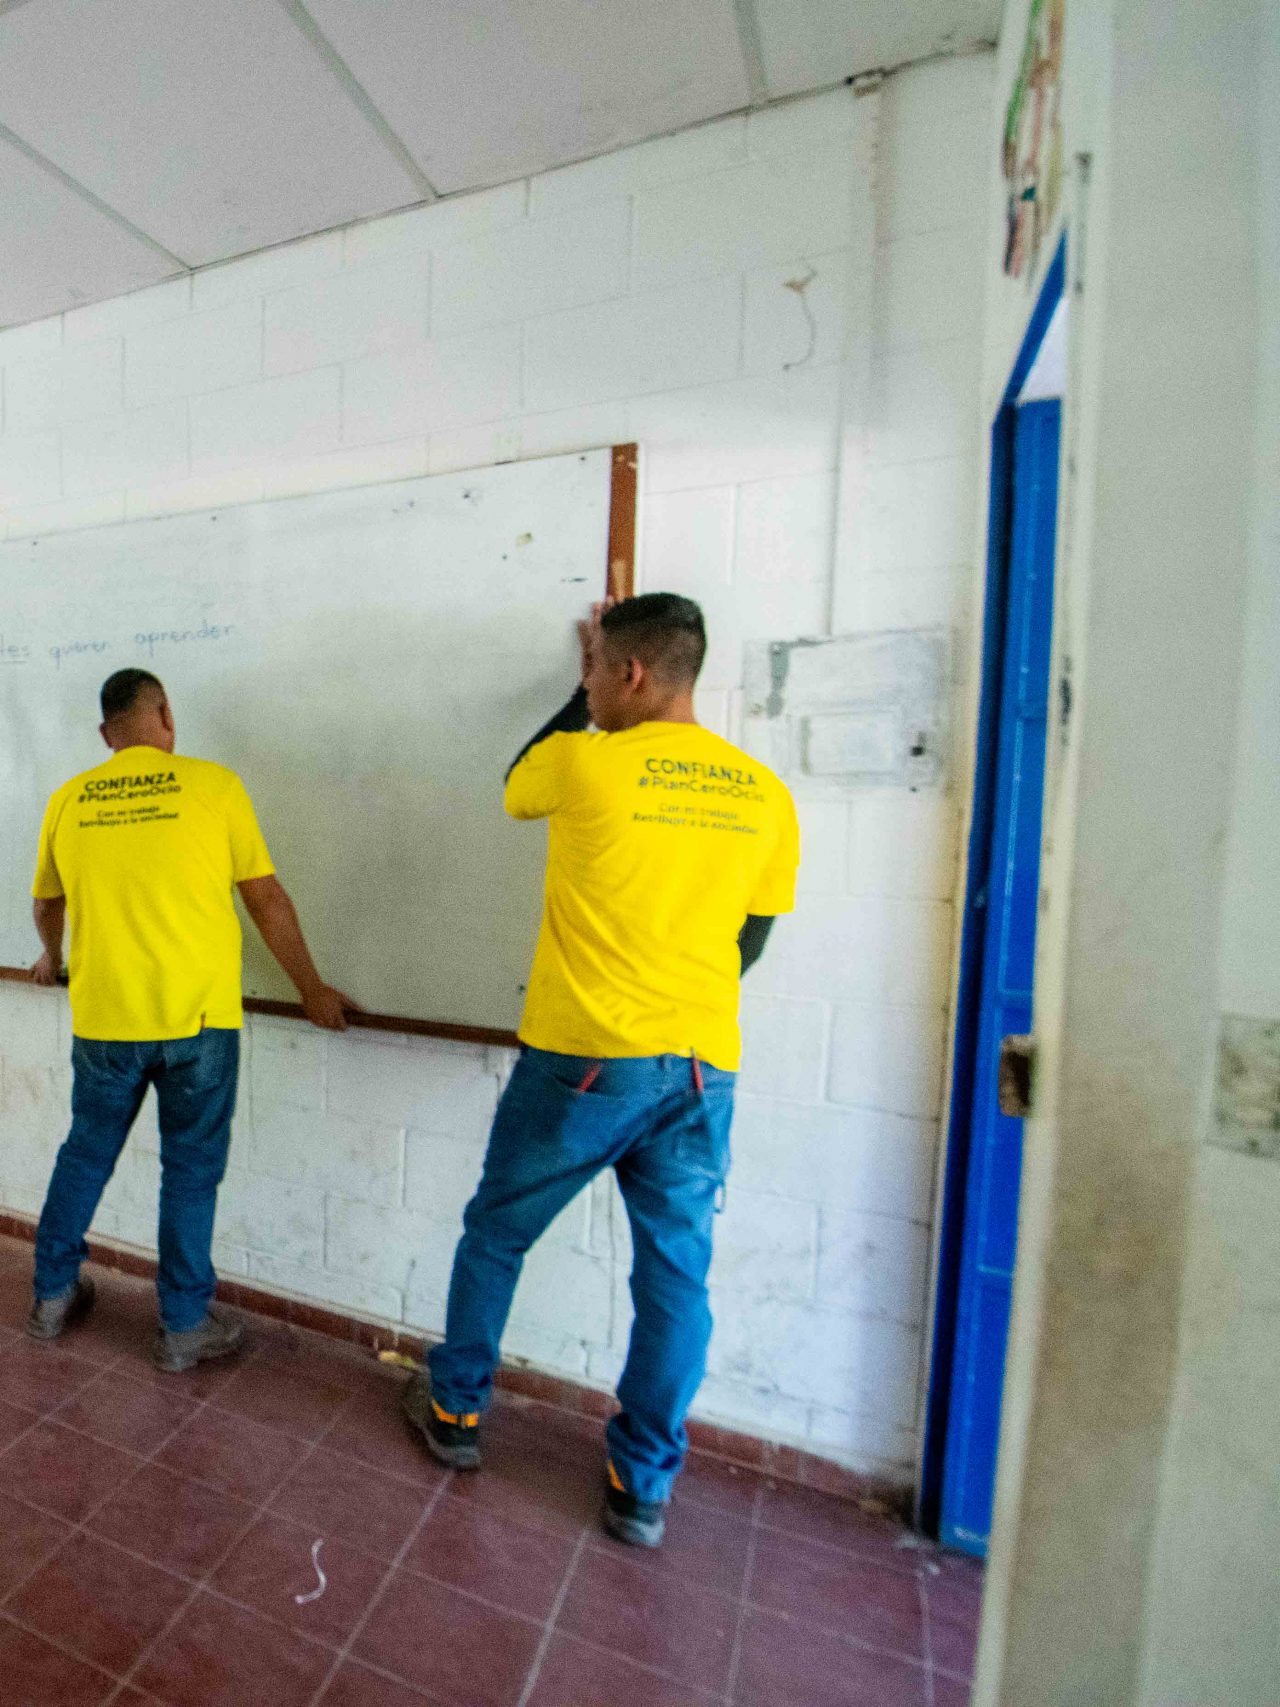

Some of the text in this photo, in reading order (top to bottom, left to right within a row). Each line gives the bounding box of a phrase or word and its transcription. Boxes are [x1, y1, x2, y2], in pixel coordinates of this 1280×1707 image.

[133, 619, 235, 657] aprender
[84, 772, 176, 792] CONFIANZA
[646, 757, 757, 786] CONFIANZA
